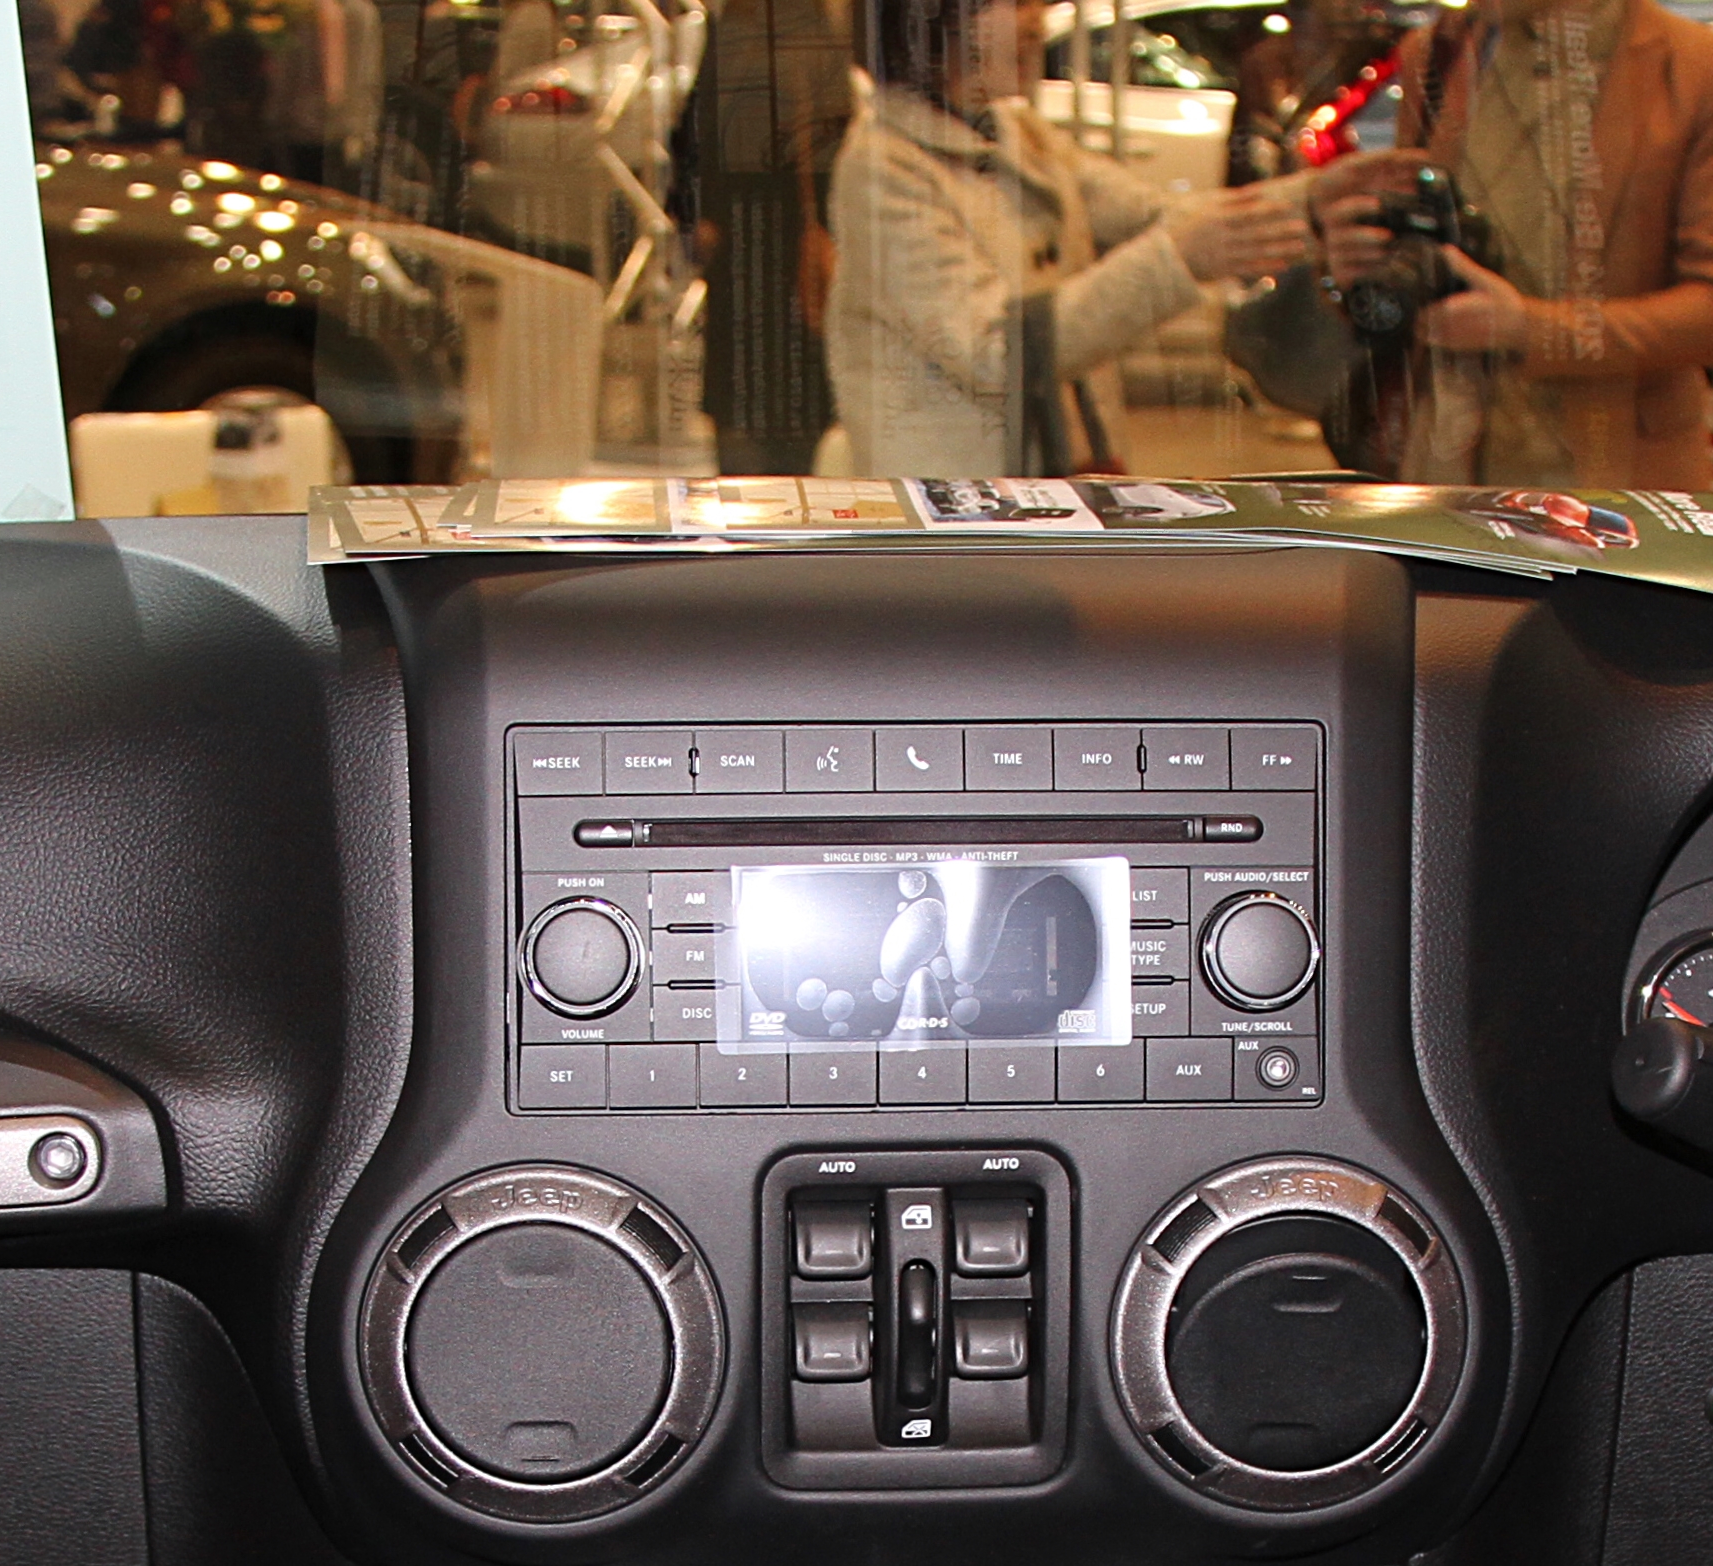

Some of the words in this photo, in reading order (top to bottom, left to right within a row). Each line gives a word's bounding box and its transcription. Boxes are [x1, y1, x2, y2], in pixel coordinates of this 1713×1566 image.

[548, 757, 580, 769] SEEK
[625, 756, 657, 768] SEEK
[720, 755, 755, 768] SCAN
[993, 753, 1022, 765] TIME
[1081, 753, 1112, 765] INFO
[1184, 754, 1204, 766] RW
[1262, 754, 1277, 766] FF
[1221, 823, 1243, 833] RND
[823, 853, 860, 862] SINGLE
[863, 852, 887, 862] DISC
[895, 852, 918, 862] MP3
[558, 878, 586, 888] PUSH
[588, 878, 604, 888] ON
[1204, 872, 1232, 882] PUSH
[1234, 871, 1309, 883] AUDIO/SELECT
[685, 894, 705, 905] AM
[686, 950, 705, 962] FM
[682, 1007, 712, 1019] DISC
[749, 1013, 786, 1025] DVD
[1221, 1021, 1292, 1033] TUNE/SCROLL
[562, 1029, 604, 1039] VOLUME
[1238, 1041, 1259, 1051] AUX
[550, 1071, 573, 1082] SET
[649, 1070, 655, 1082] 1
[737, 1068, 747, 1080] 2
[828, 1067, 838, 1080] 3
[917, 1066, 928, 1079] 4
[1006, 1065, 1015, 1078] 5
[1096, 1065, 1105, 1077] 6
[1176, 1065, 1202, 1077] AUX
[819, 1161, 856, 1173] AUTO
[982, 1158, 1019, 1170] AUTO
[1250, 1175, 1339, 1202] Jeep
[490, 1184, 583, 1212] Jeep
